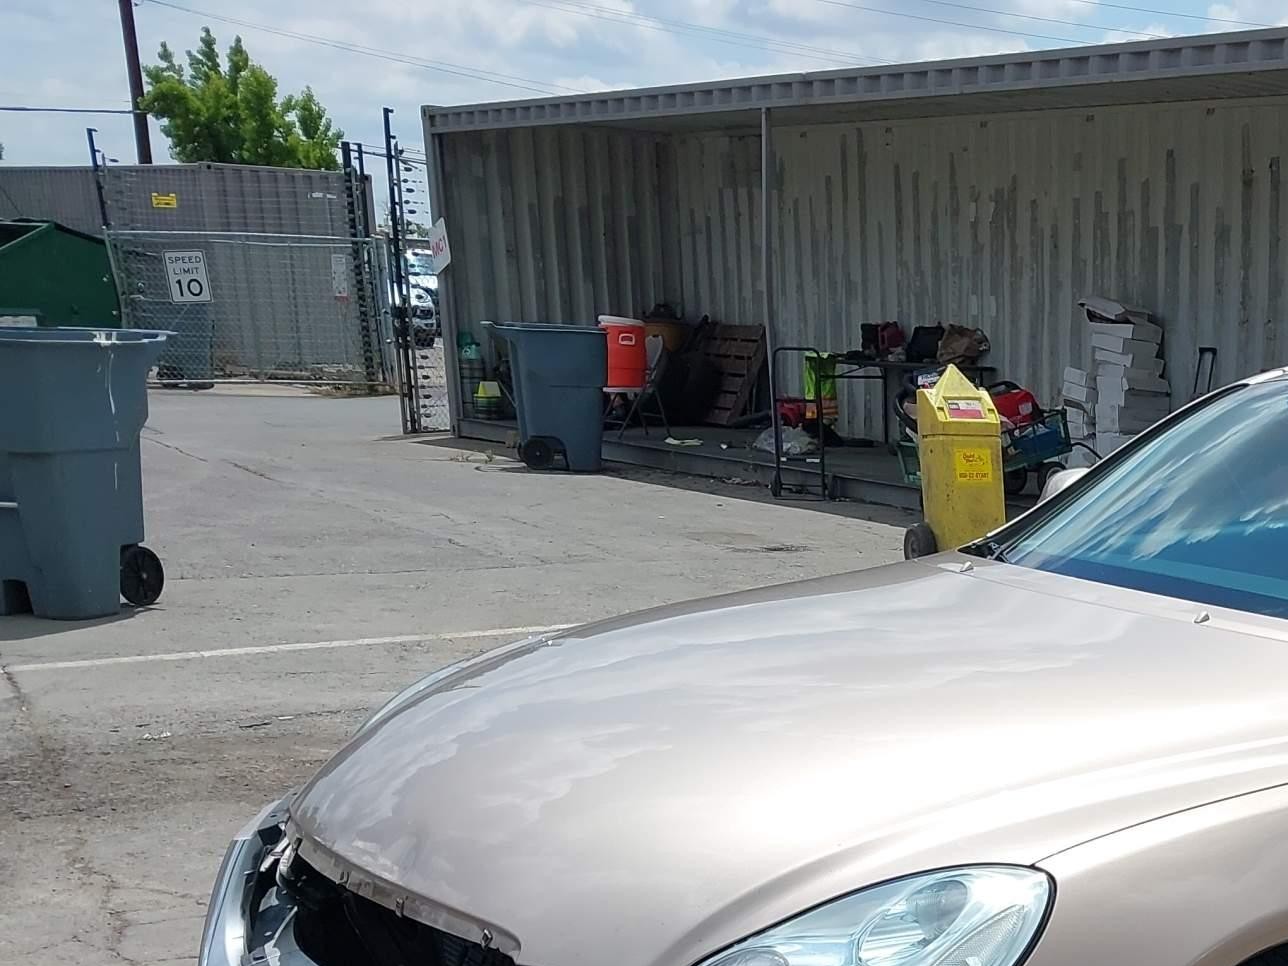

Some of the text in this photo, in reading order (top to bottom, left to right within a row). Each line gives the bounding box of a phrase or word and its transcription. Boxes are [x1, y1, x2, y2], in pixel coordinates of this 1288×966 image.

[168, 255, 201, 264] SPEED
[173, 267, 200, 276] LIMIT
[176, 278, 204, 297] 10
